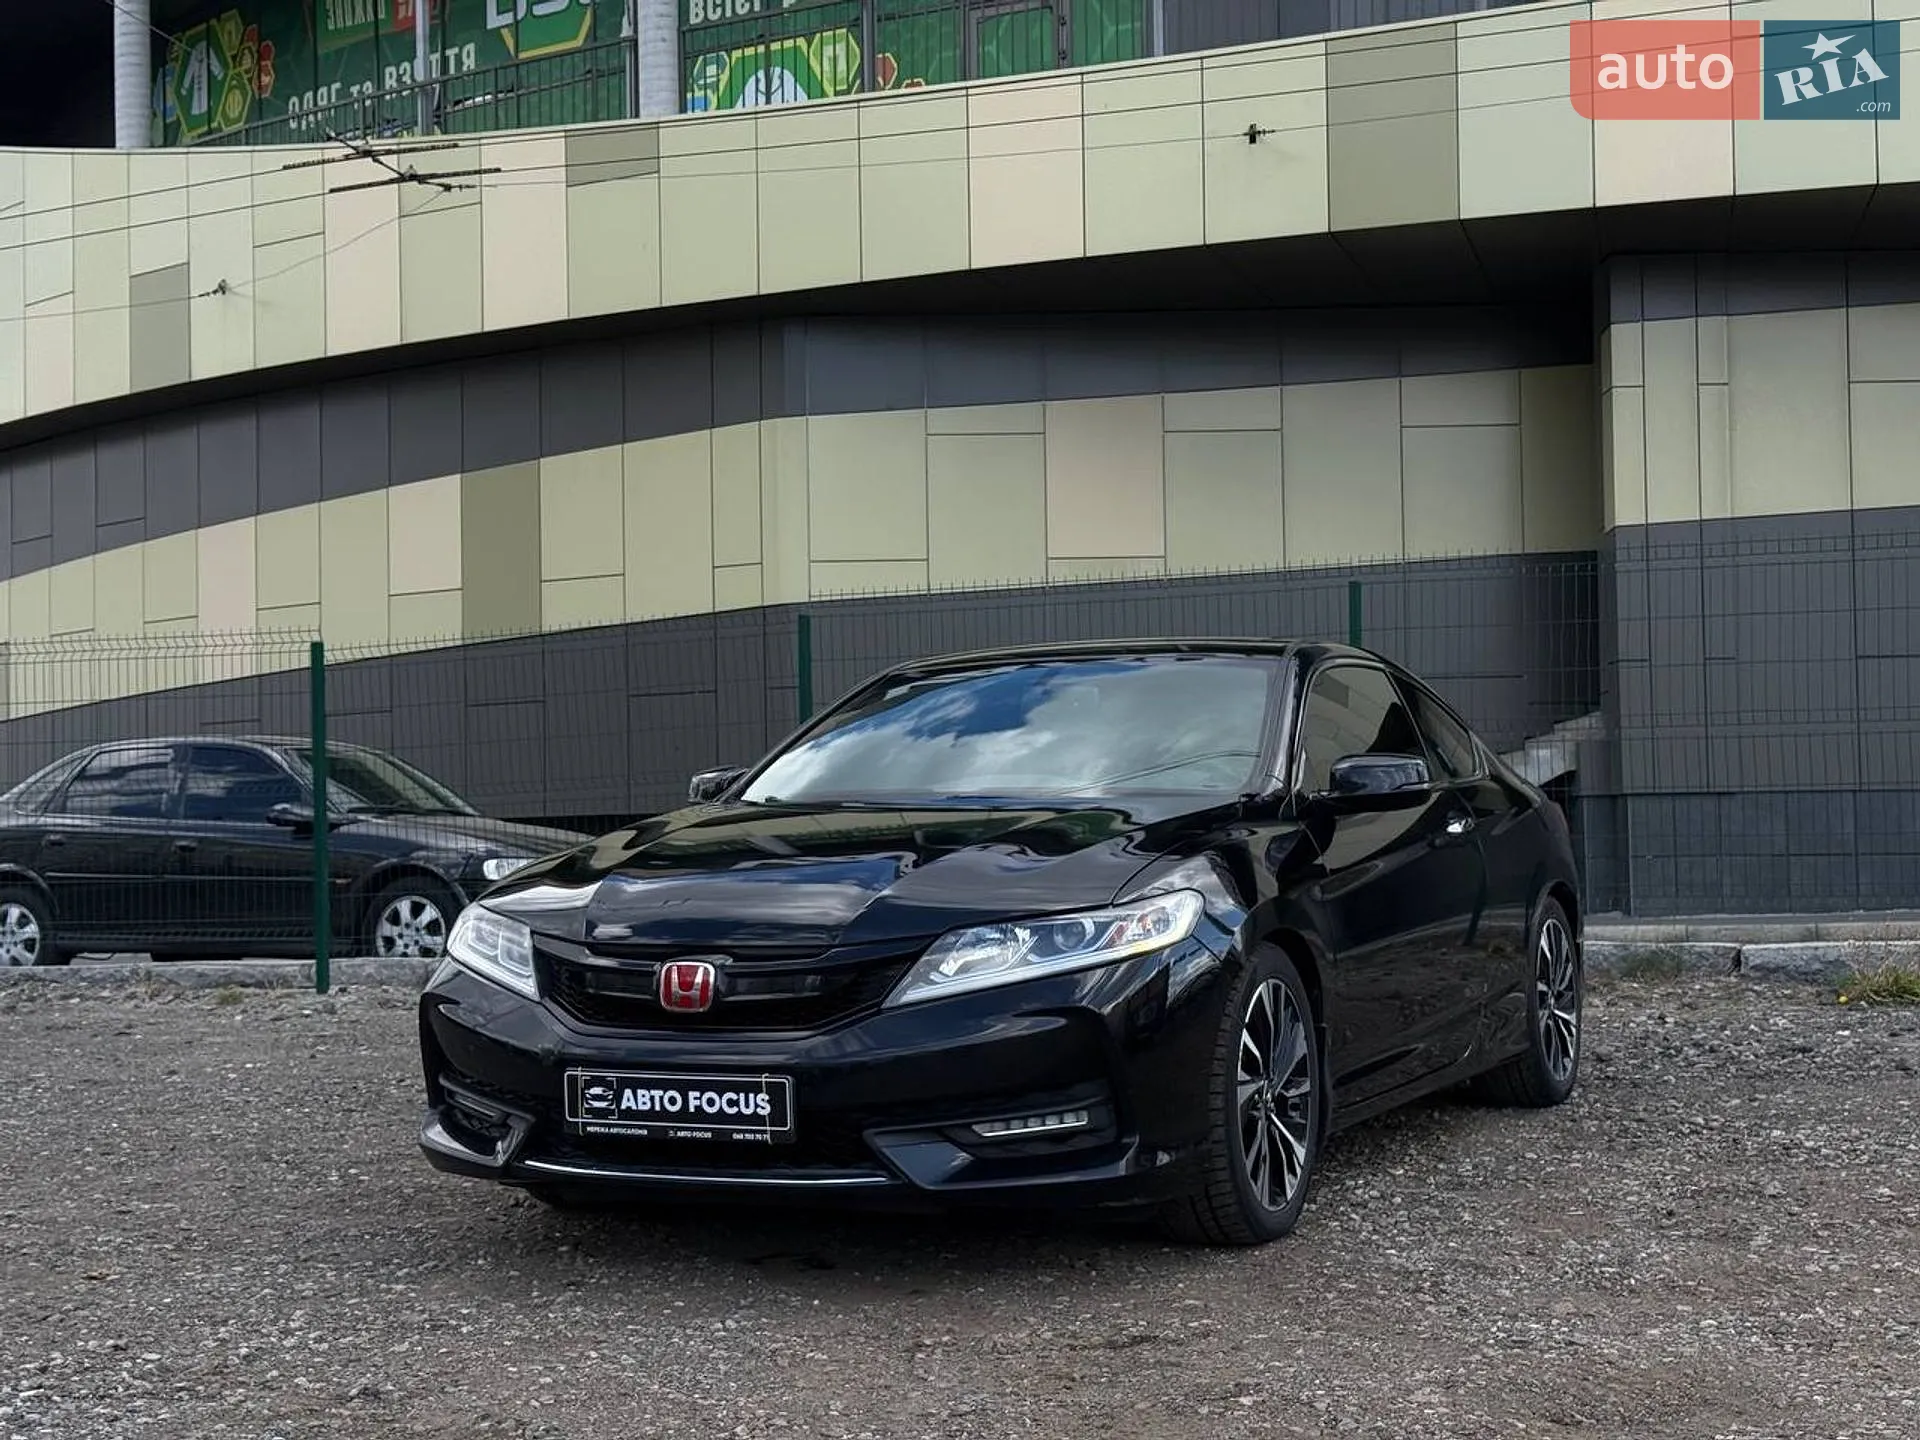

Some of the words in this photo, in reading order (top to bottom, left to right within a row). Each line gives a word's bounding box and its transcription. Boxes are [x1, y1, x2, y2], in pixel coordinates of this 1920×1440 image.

[384, 42, 476, 100] ВЗТТЯ
[620, 1088, 683, 1112] АВТО
[688, 1091, 772, 1116] FOCUS
